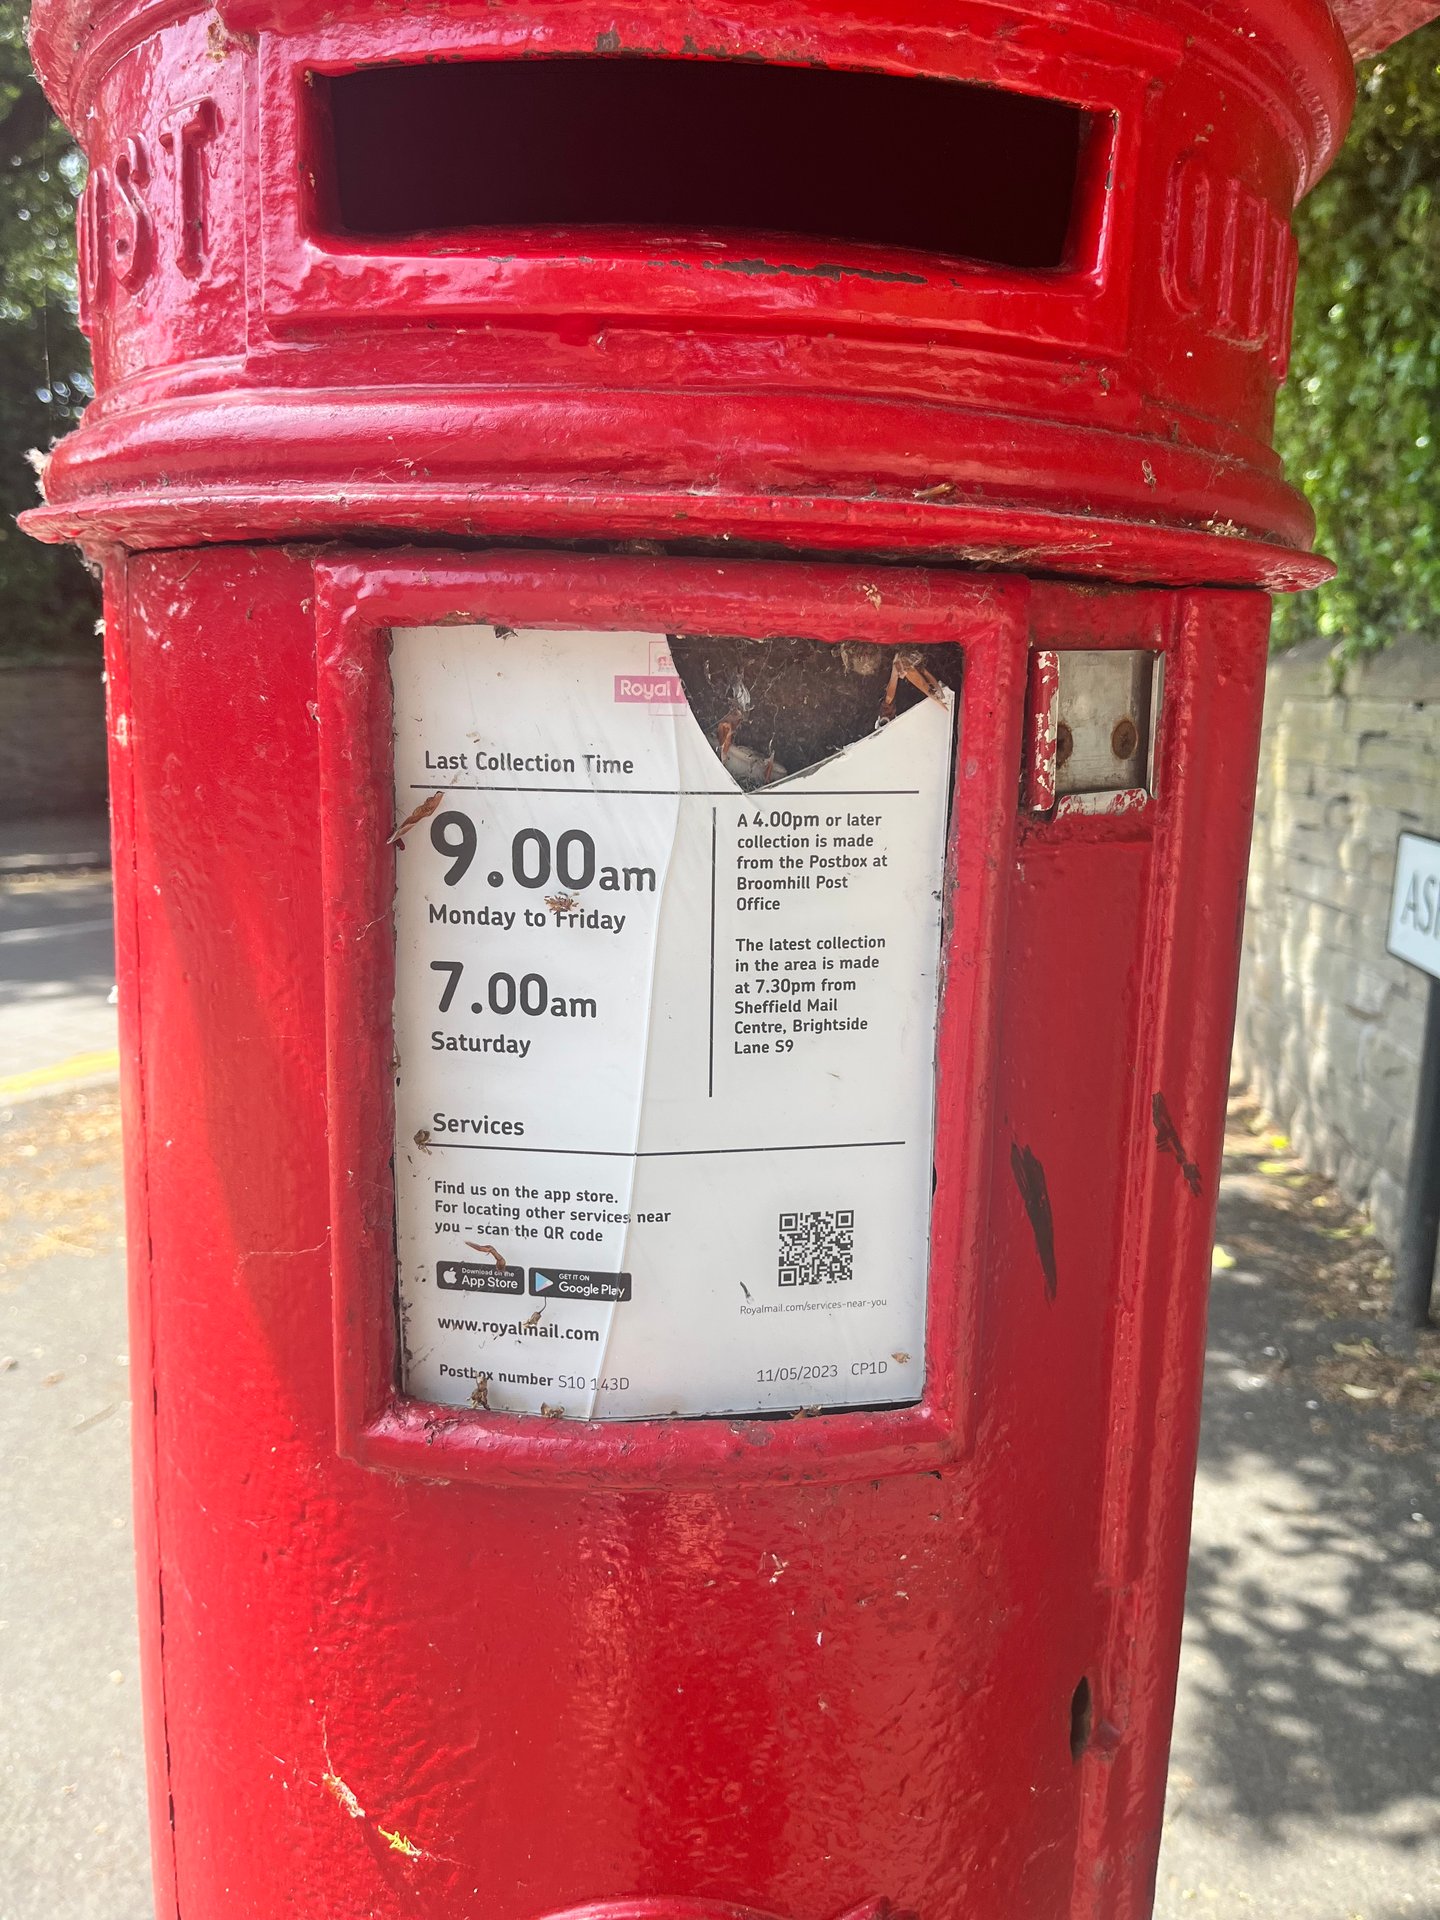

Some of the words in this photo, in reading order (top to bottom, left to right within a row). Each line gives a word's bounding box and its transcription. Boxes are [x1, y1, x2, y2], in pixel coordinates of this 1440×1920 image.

[620, 679, 672, 701] Royal
[425, 750, 468, 770] Last
[475, 751, 575, 773] Collection
[583, 754, 634, 774] Time
[737, 813, 748, 828] A
[752, 810, 820, 831] 4.00pm
[825, 816, 842, 827] or
[846, 812, 883, 827] later
[430, 810, 656, 892] 9.00am
[737, 834, 810, 849] collection
[815, 833, 828, 848] is
[832, 833, 874, 848] made
[736, 855, 774, 870] from
[778, 855, 804, 869] the
[809, 854, 868, 869] Postbox
[872, 854, 888, 867] at
[737, 875, 810, 891] Broomhill
[816, 875, 849, 889] Post
[736, 896, 781, 911] Office
[1401, 870, 1440, 940] AS
[428, 903, 516, 931] Monday
[523, 908, 546, 928] to
[553, 905, 626, 935] Friday
[735, 938, 764, 952] The
[769, 937, 812, 951] latest
[816, 935, 886, 950] collection
[735, 958, 749, 973] in
[754, 958, 779, 972] the
[784, 960, 817, 971] area
[822, 956, 834, 970] is
[839, 955, 880, 970] made
[429, 960, 597, 1019] 7.00am
[734, 981, 751, 994] at
[755, 978, 816, 996] 7.30pm
[820, 978, 856, 992] from
[734, 999, 802, 1015] Sheffield
[807, 998, 838, 1013] Mail
[734, 1020, 787, 1035] Centre,
[792, 1016, 868, 1035] Brightside
[431, 1030, 531, 1059] Saturday
[734, 1041, 770, 1055] Lane
[775, 1039, 794, 1053] S9
[432, 1112, 525, 1136] Services
[434, 1180, 465, 1195] Find
[470, 1185, 487, 1196] us
[492, 1187, 510, 1198] on
[514, 1185, 539, 1199] the
[544, 1189, 571, 1204] app
[576, 1189, 618, 1204] store.
[435, 1199, 459, 1214] For
[463, 1201, 520, 1221] locating
[525, 1206, 566, 1220] other
[570, 1209, 632, 1224] services
[636, 1212, 672, 1224] near
[434, 1221, 461, 1235] you
[477, 1224, 510, 1236] scan
[514, 1224, 538, 1240] the
[543, 1225, 564, 1240] QR
[569, 1228, 603, 1242] code
[462, 1275, 485, 1288] App
[488, 1276, 518, 1288] Store
[559, 1281, 599, 1296] Google
[601, 1284, 625, 1298] Play
[740, 1299, 887, 1315] Royalmail.com/services-near-you
[438, 1317, 599, 1341] www.royalmail.com
[438, 1363, 495, 1382] Postbox
[498, 1372, 554, 1387] number
[558, 1374, 586, 1390] S10
[756, 1364, 838, 1382] 11/05/2023
[851, 1360, 888, 1376] CP1D
